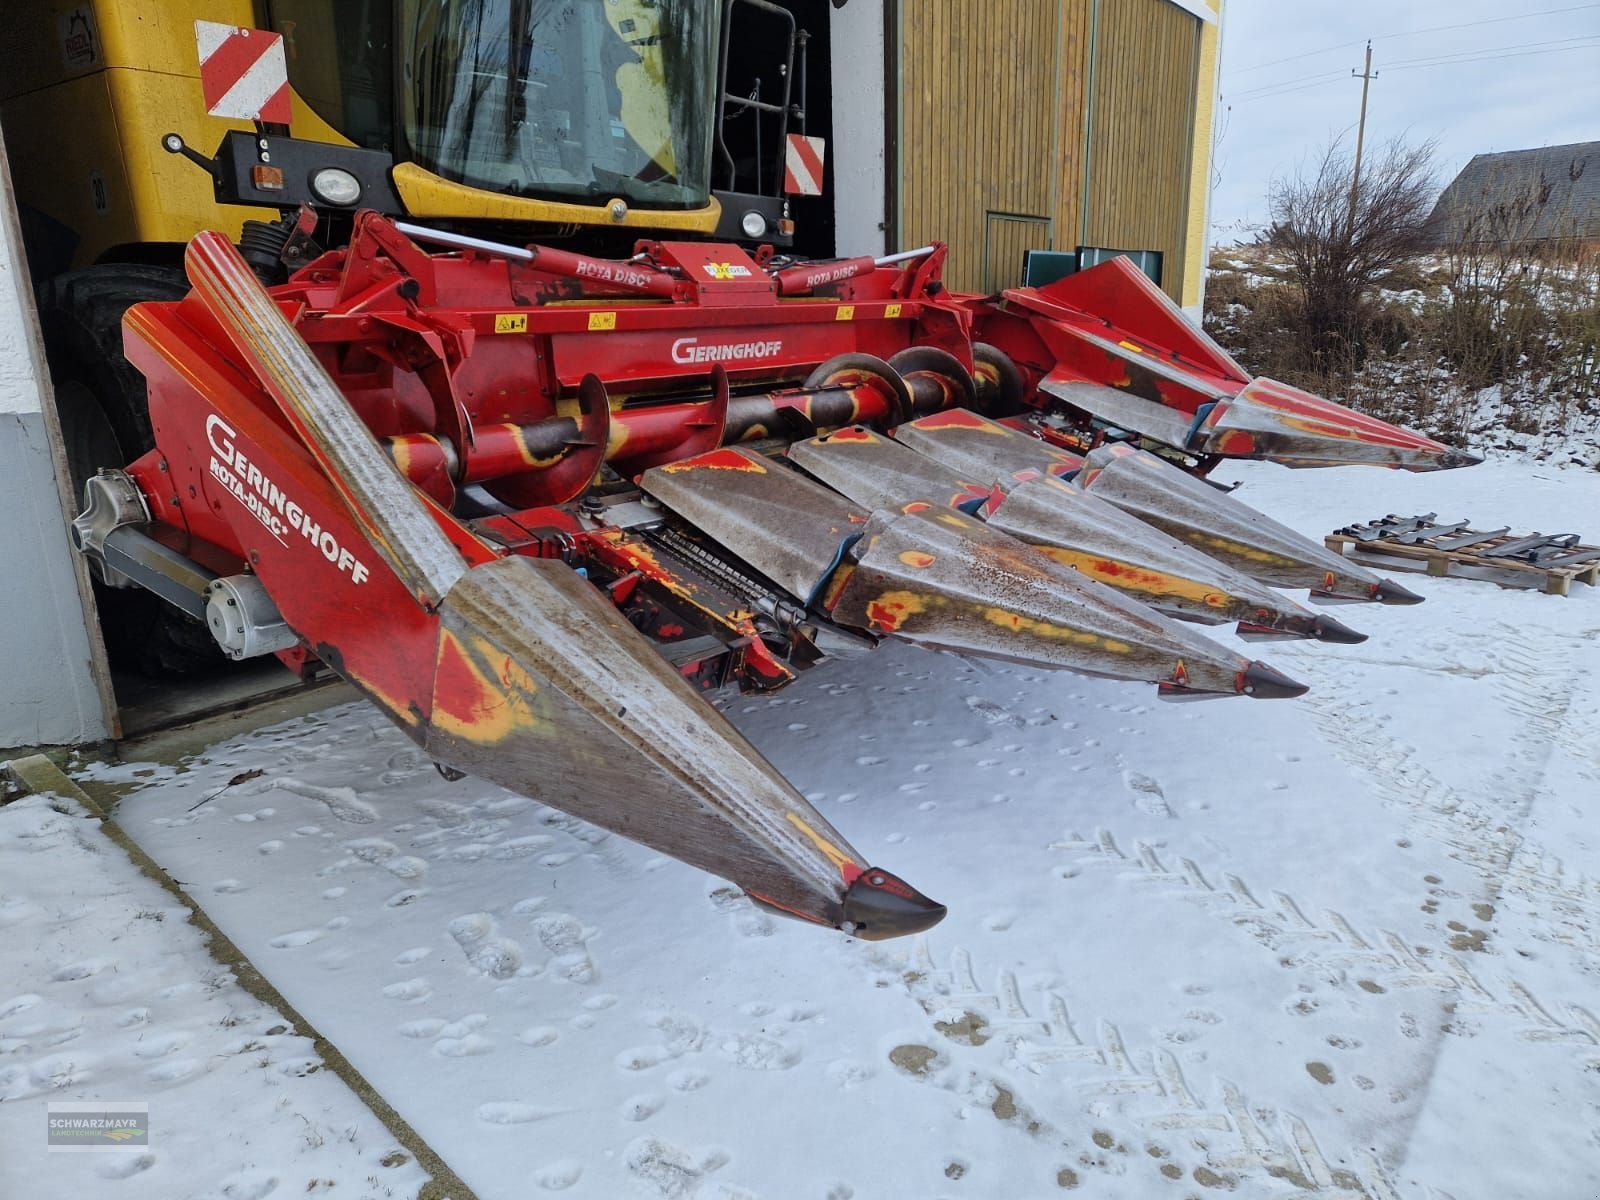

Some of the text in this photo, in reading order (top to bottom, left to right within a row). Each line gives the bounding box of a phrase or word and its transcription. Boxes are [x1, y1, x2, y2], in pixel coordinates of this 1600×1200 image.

[576, 261, 612, 280] ROTA
[806, 274, 831, 287] ROTA
[672, 337, 782, 364] GERINGHOFF
[206, 414, 369, 585] GERINGHOFF
